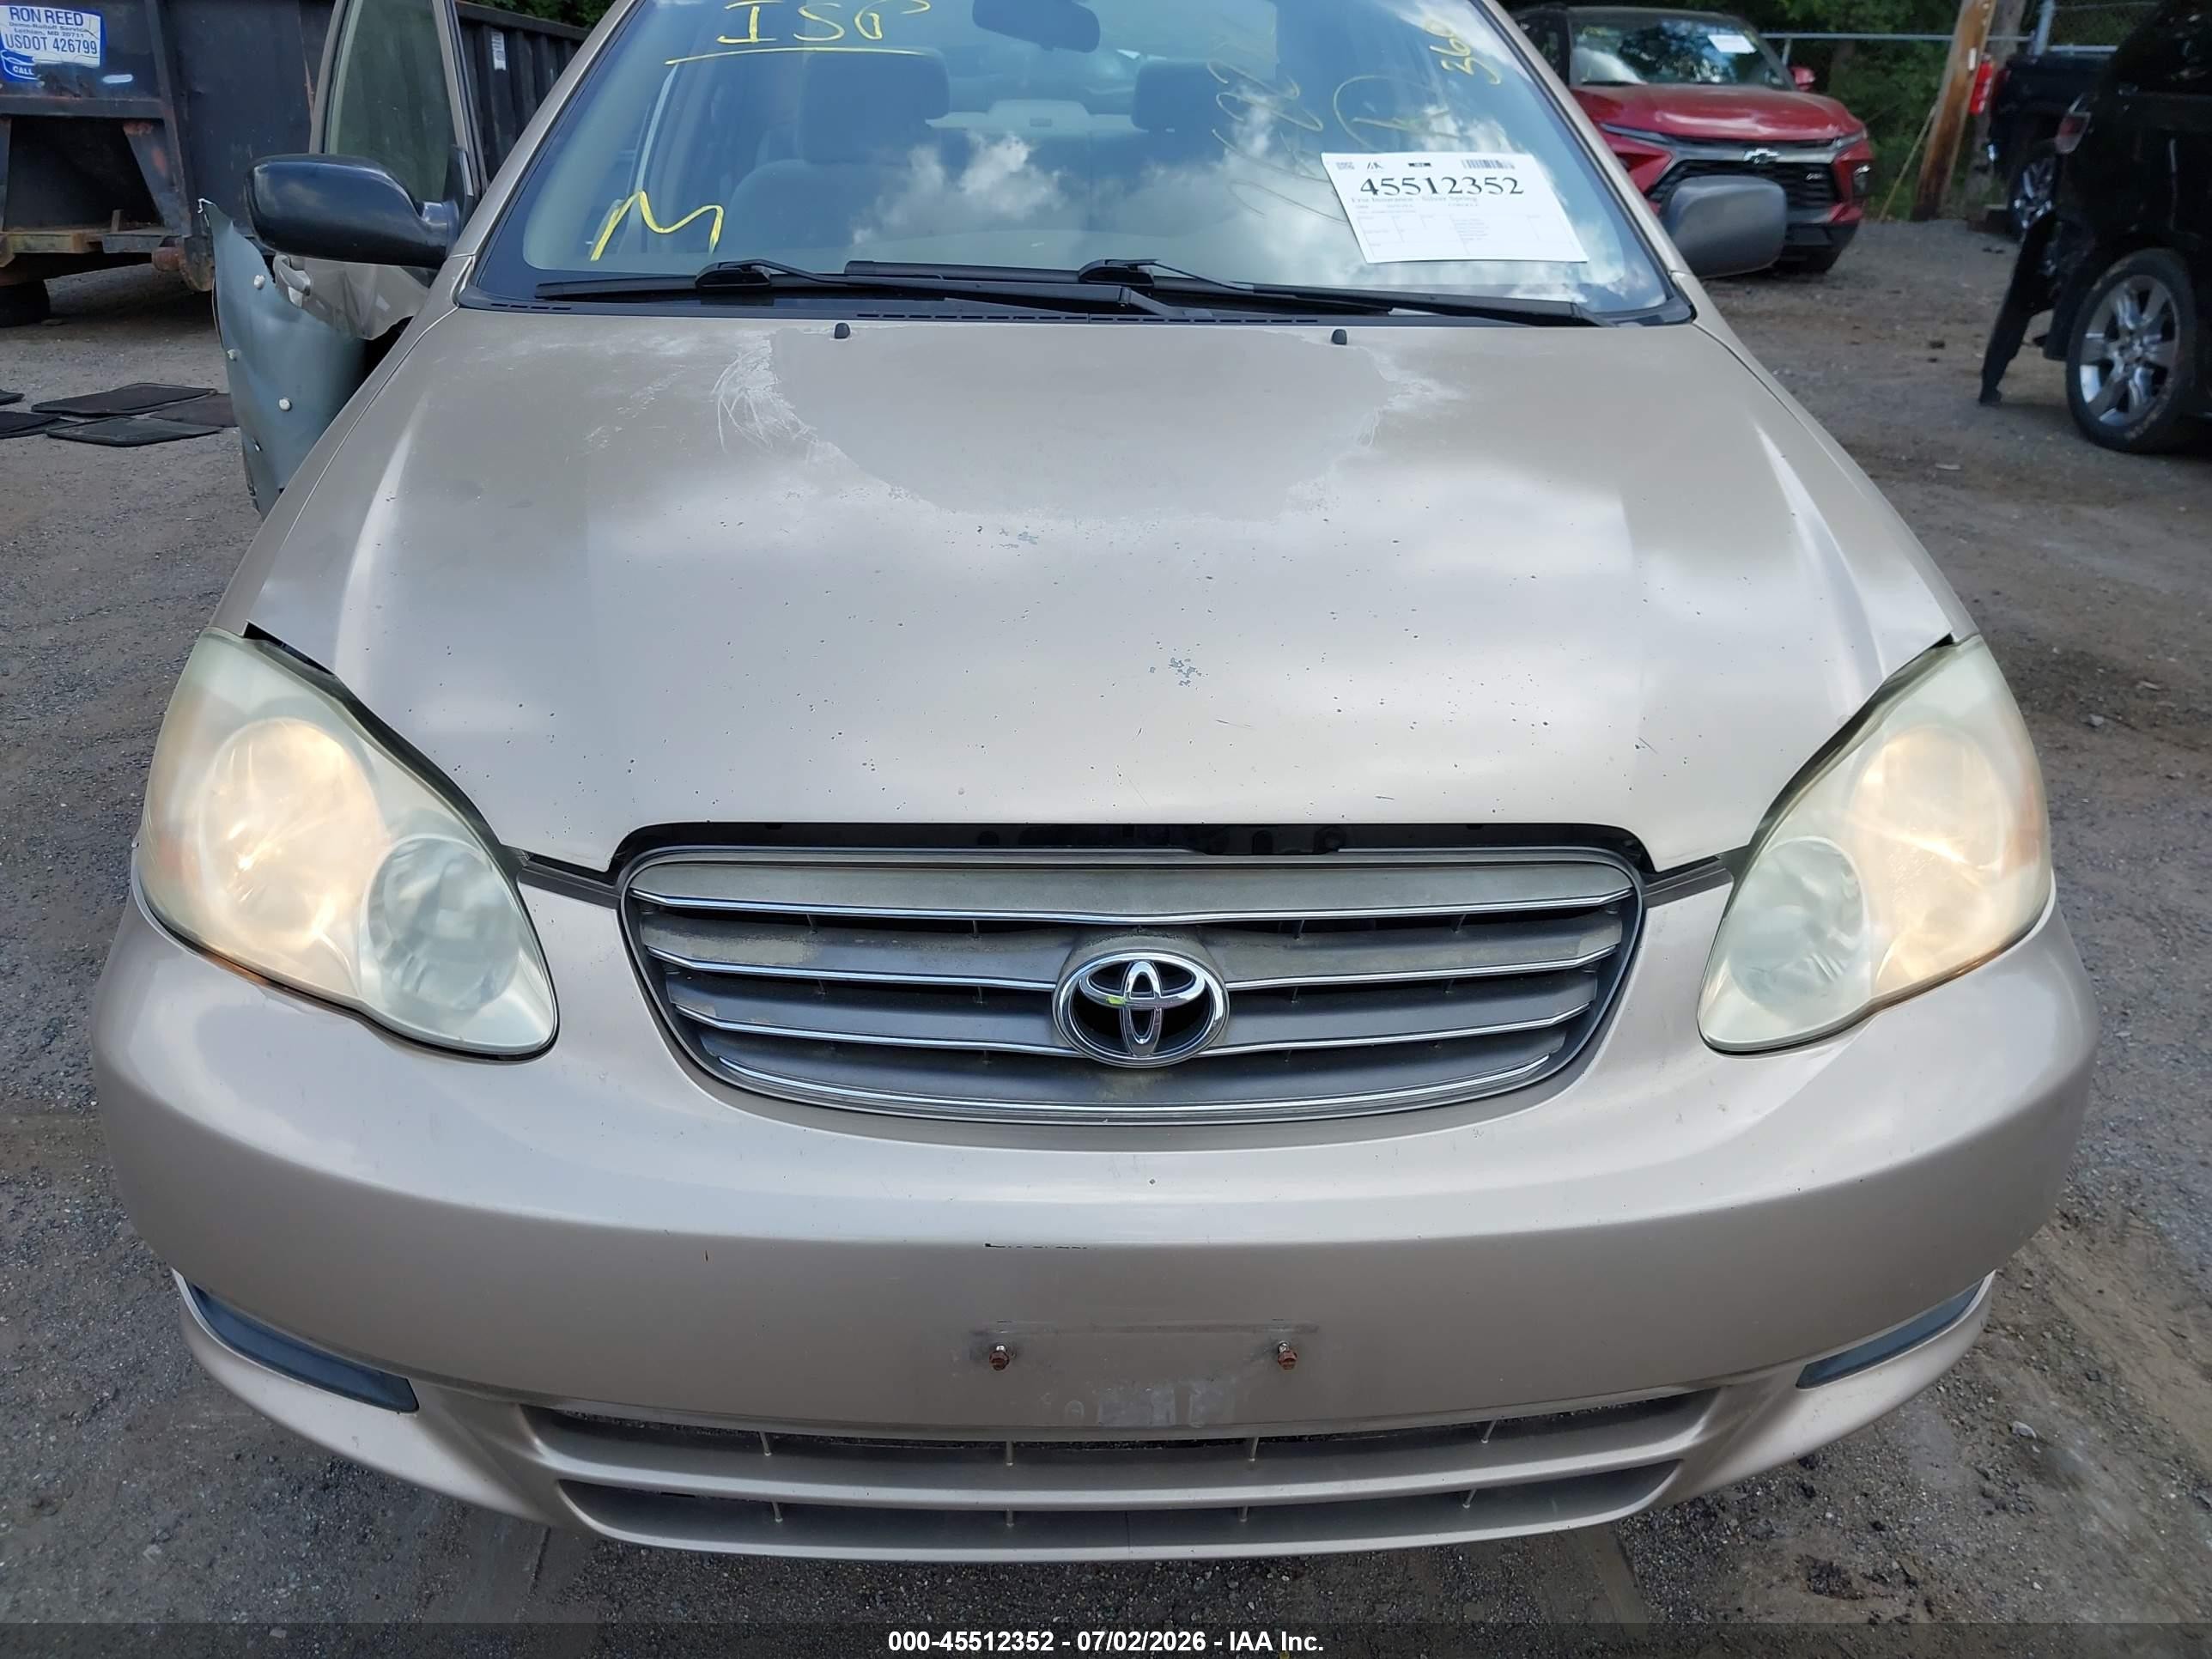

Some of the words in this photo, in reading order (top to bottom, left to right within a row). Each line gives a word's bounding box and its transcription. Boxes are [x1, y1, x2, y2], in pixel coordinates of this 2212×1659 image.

[9, 7, 41, 22] RON
[45, 9, 84, 27] REED
[5, 33, 48, 51] USDOT
[53, 39, 98, 54] 426799
[13, 65, 34, 76] CALL
[1360, 176, 1524, 196] 45512352
